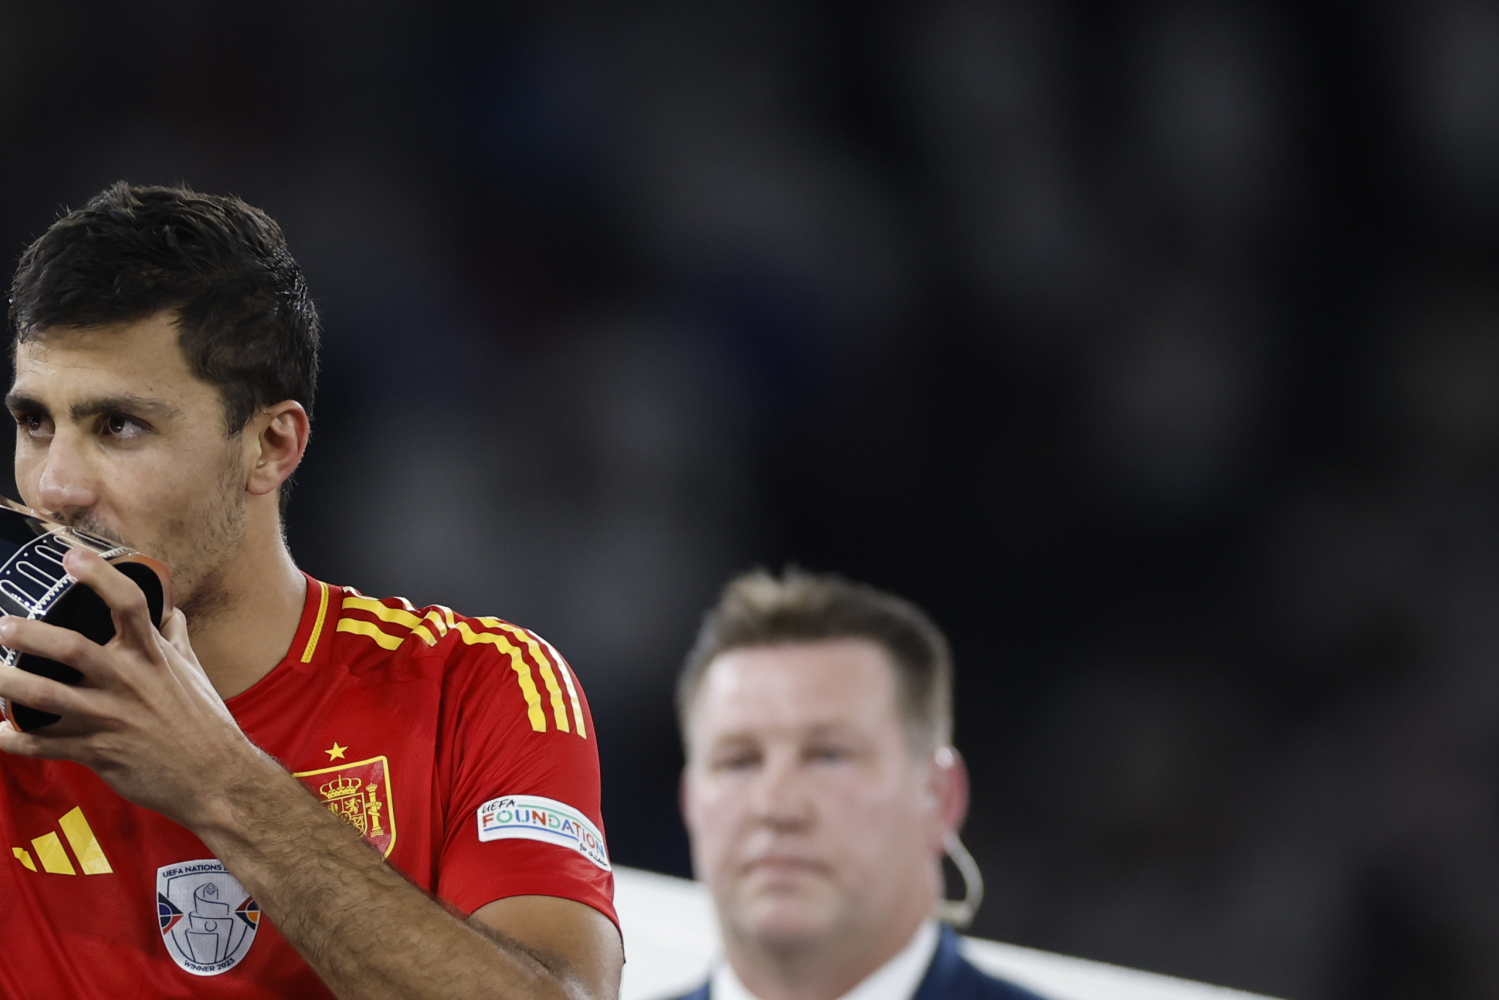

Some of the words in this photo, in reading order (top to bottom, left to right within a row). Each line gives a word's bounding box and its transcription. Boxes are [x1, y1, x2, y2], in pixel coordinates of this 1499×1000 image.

[482, 799, 515, 813] UEFA
[482, 809, 605, 858] FOUNDATION
[162, 868, 184, 878] UEFA
[185, 864, 222, 873] NATIONS
[184, 960, 215, 972] WINNER
